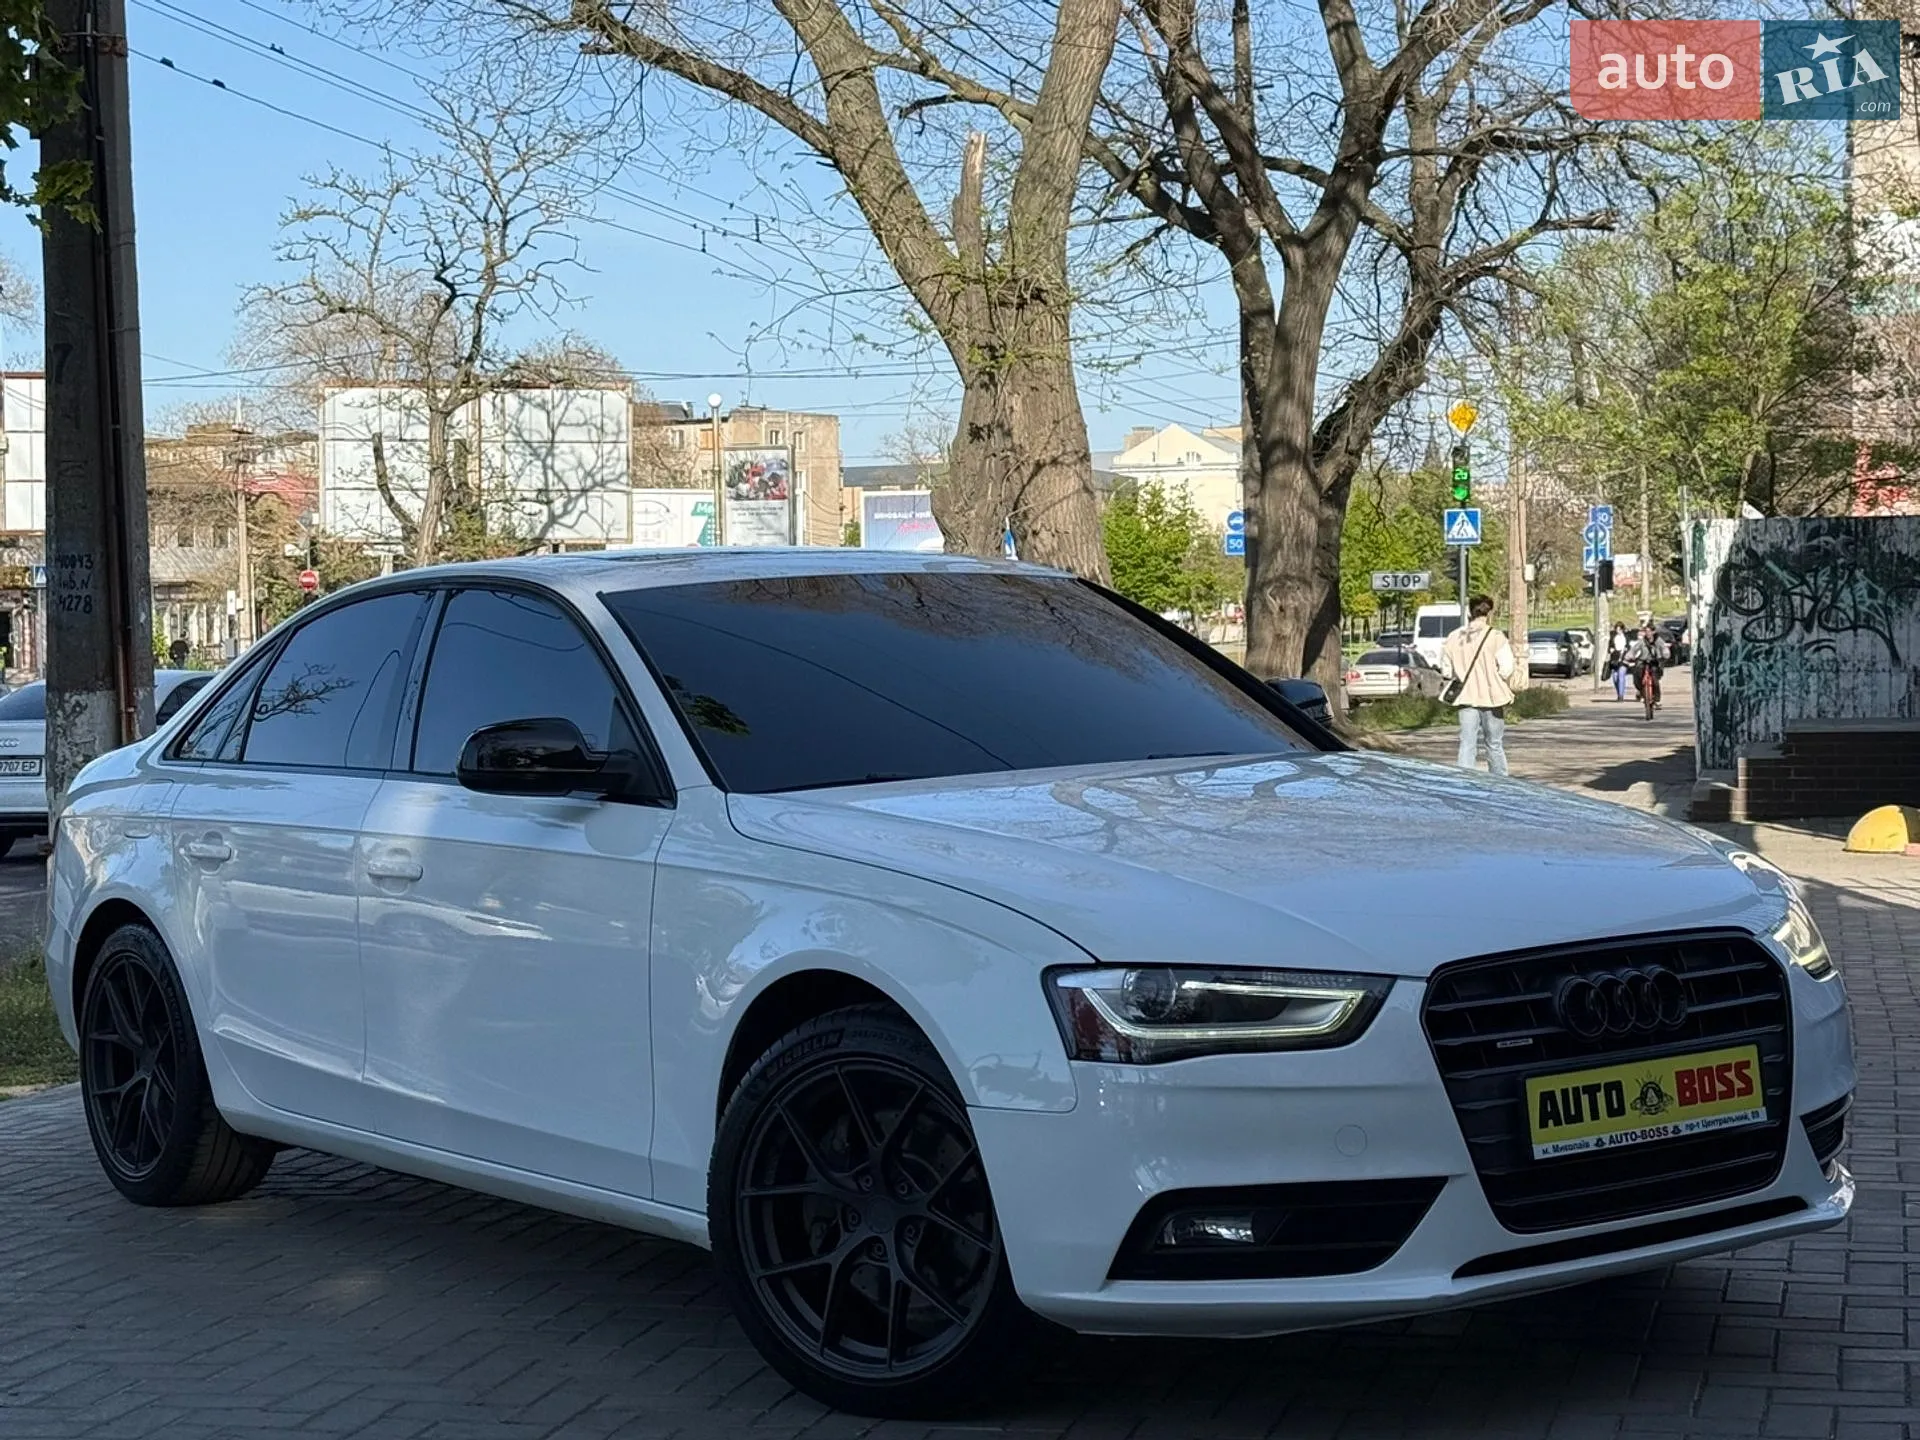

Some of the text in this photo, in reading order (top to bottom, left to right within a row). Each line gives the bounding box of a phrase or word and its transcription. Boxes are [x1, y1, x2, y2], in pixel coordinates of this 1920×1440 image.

[1382, 574, 1421, 588] STOP
[1538, 1060, 1754, 1129] AUTO BOSS
[1608, 1126, 1669, 1146] AUTO-BOSS
